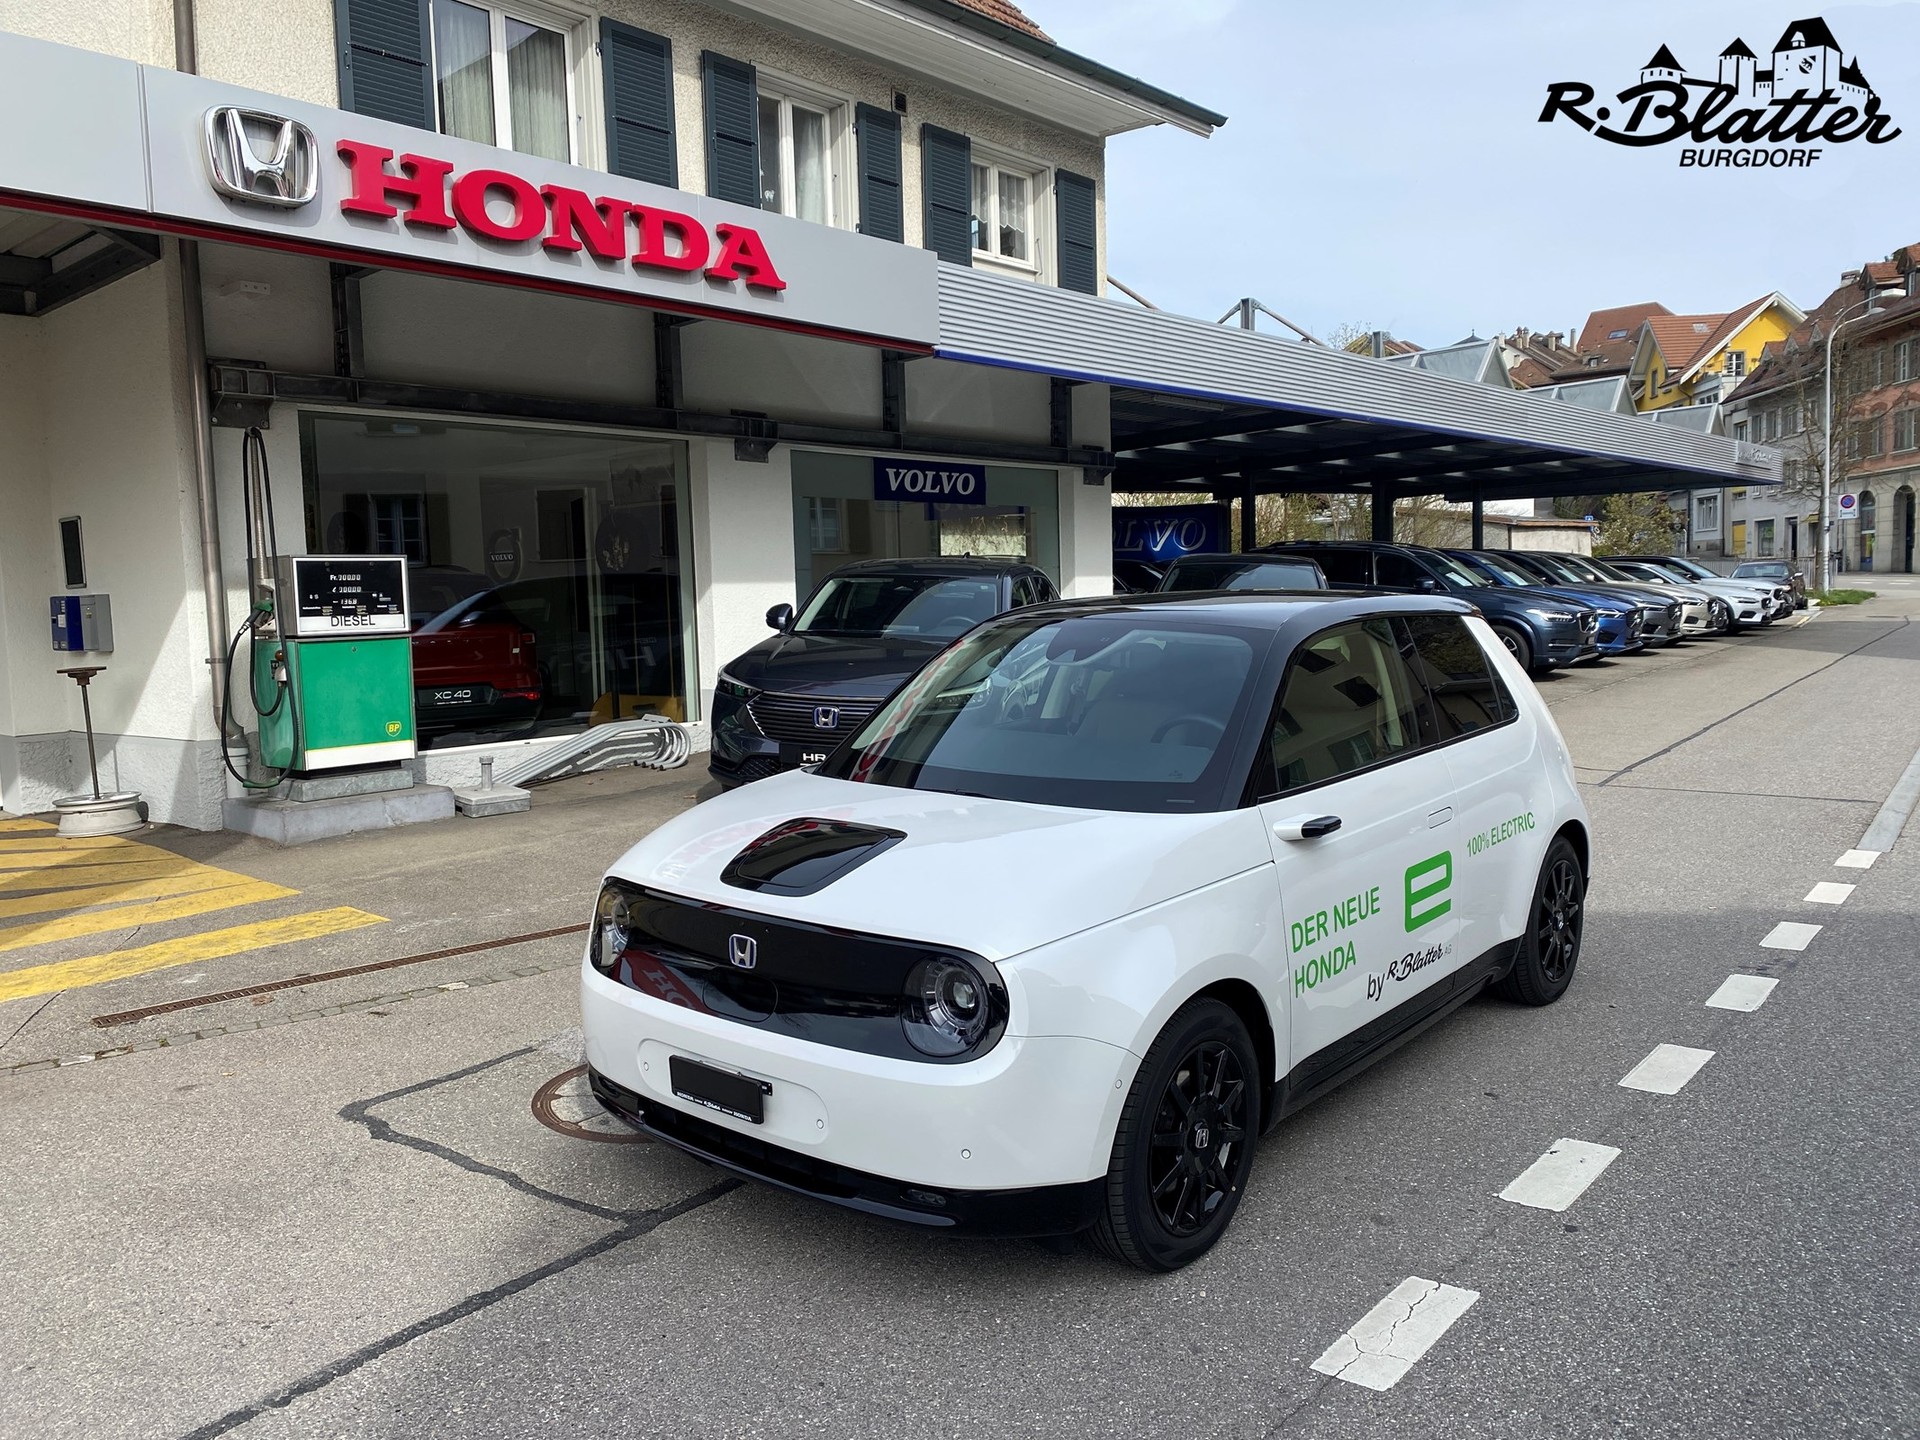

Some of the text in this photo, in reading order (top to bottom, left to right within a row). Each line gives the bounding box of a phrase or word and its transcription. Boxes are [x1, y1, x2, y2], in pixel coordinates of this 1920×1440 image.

[336, 139, 787, 291] HONDA
[885, 468, 976, 495] VOLVO
[1112, 518, 1206, 551] LVO
[490, 553, 514, 562] VOLVO
[330, 614, 376, 627] DIESEL
[388, 723, 400, 733] BP
[1466, 811, 1536, 857] 100% ELECTRIC
[1404, 850, 1453, 933] e
[1291, 886, 1381, 953] DER NEUE
[1294, 940, 1357, 999] HONDA
[1366, 973, 1386, 1002] by
